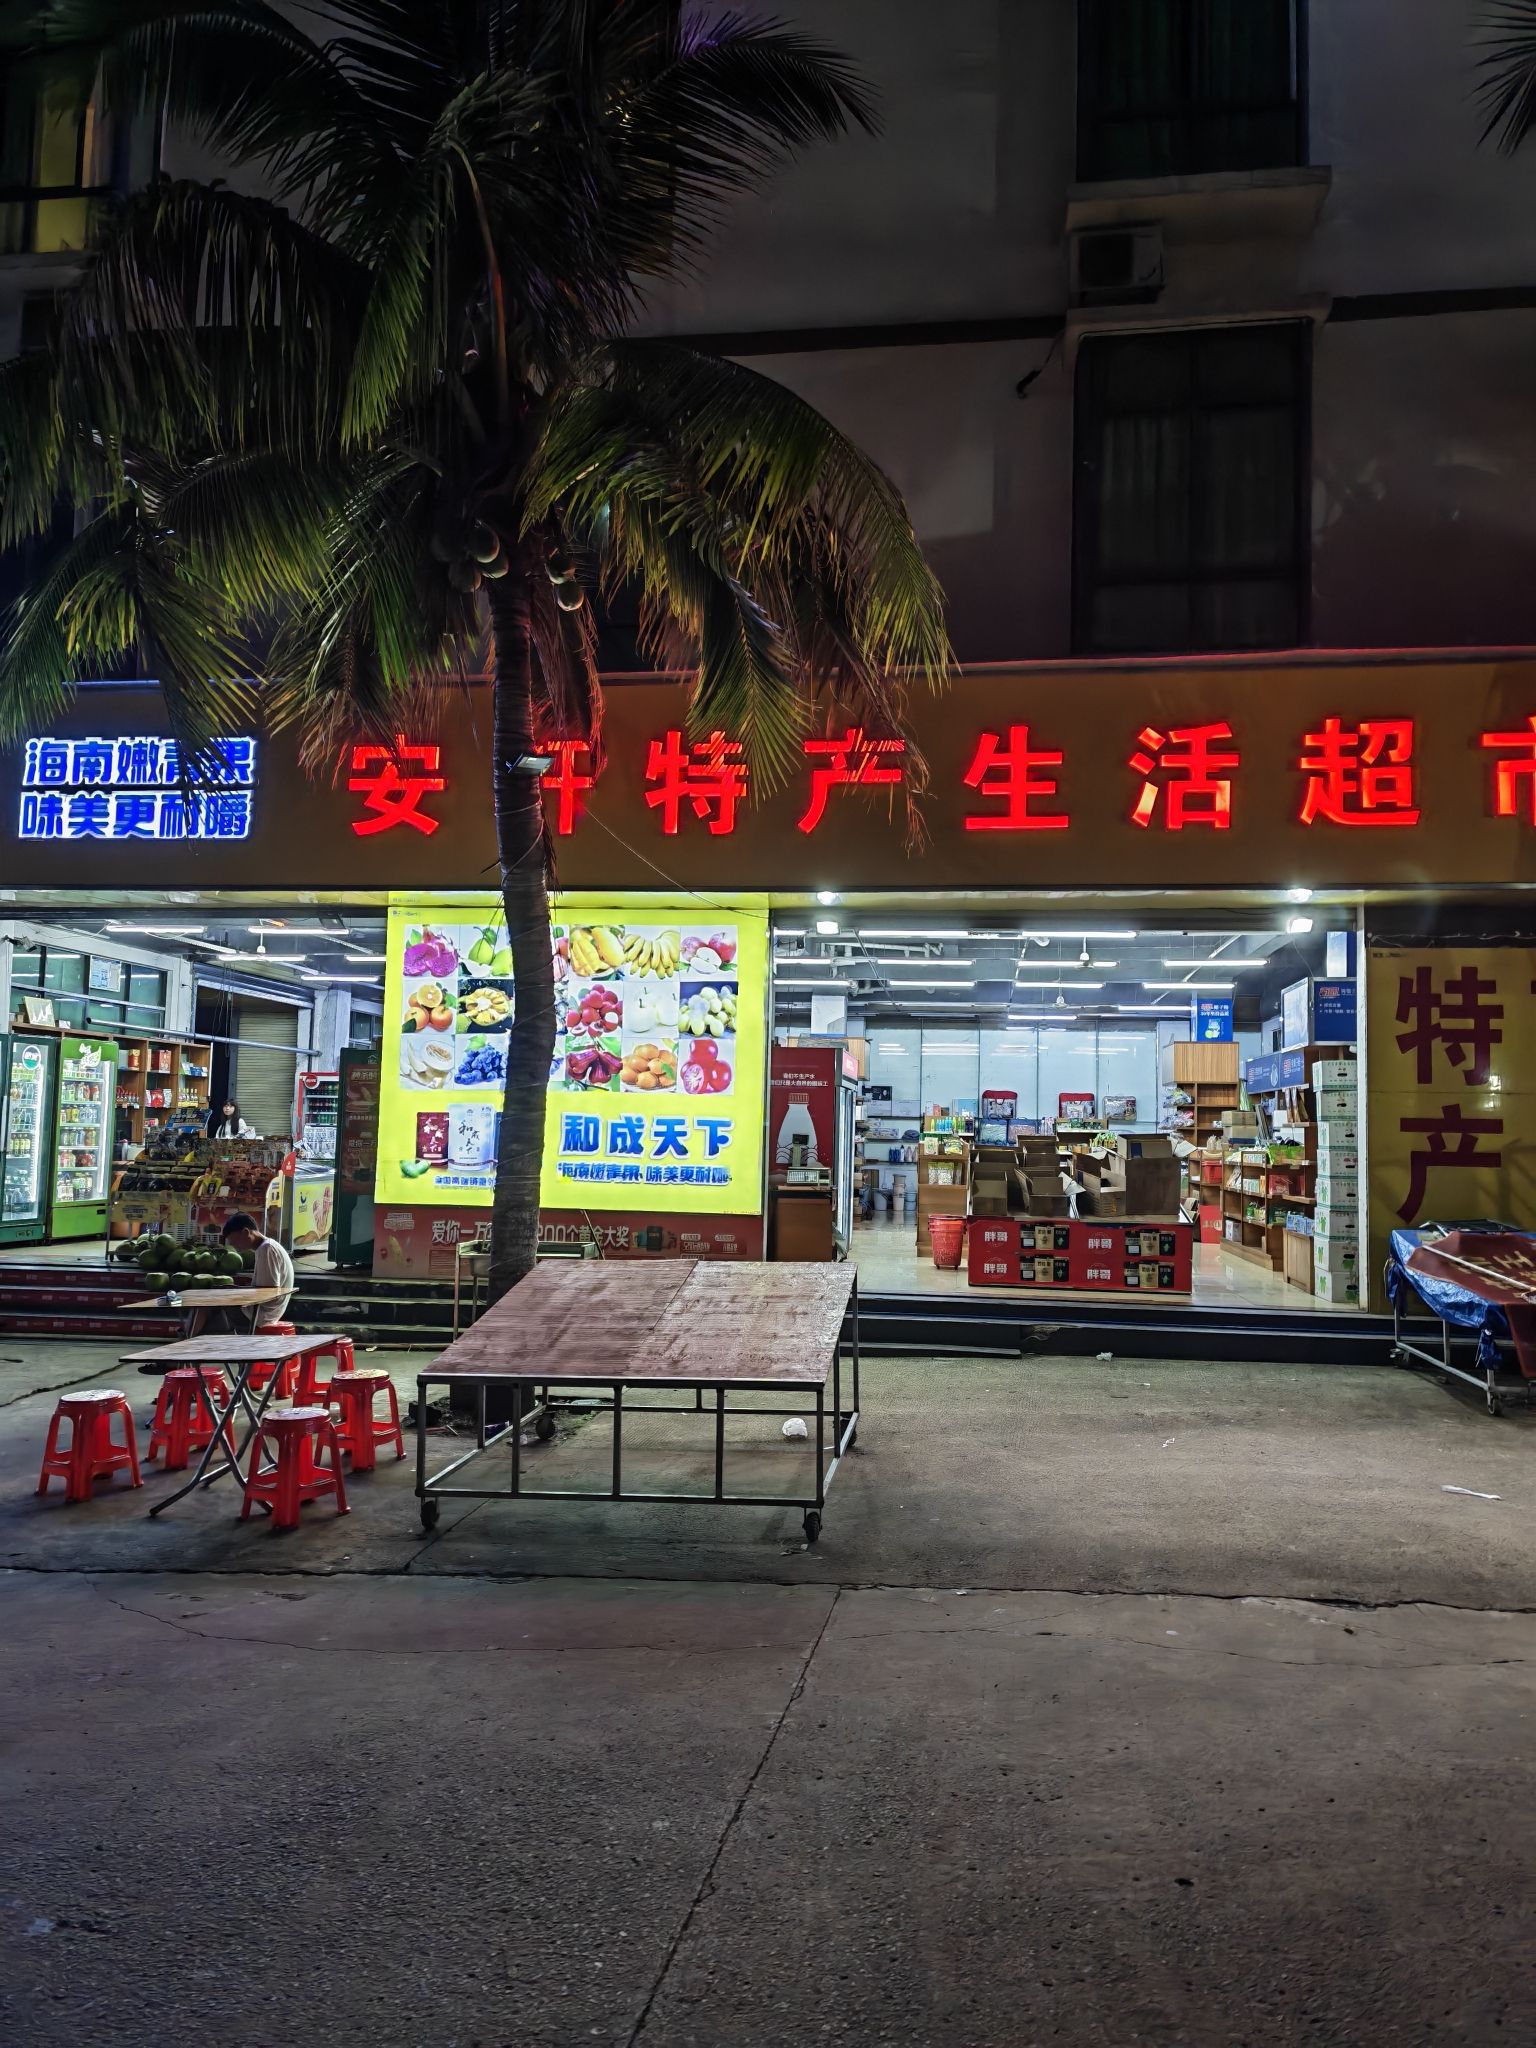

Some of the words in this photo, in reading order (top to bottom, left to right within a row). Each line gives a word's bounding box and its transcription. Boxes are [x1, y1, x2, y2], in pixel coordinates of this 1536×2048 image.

[560, 1113, 734, 1159] 和成天下
[1395, 966, 1504, 1225] 特产
